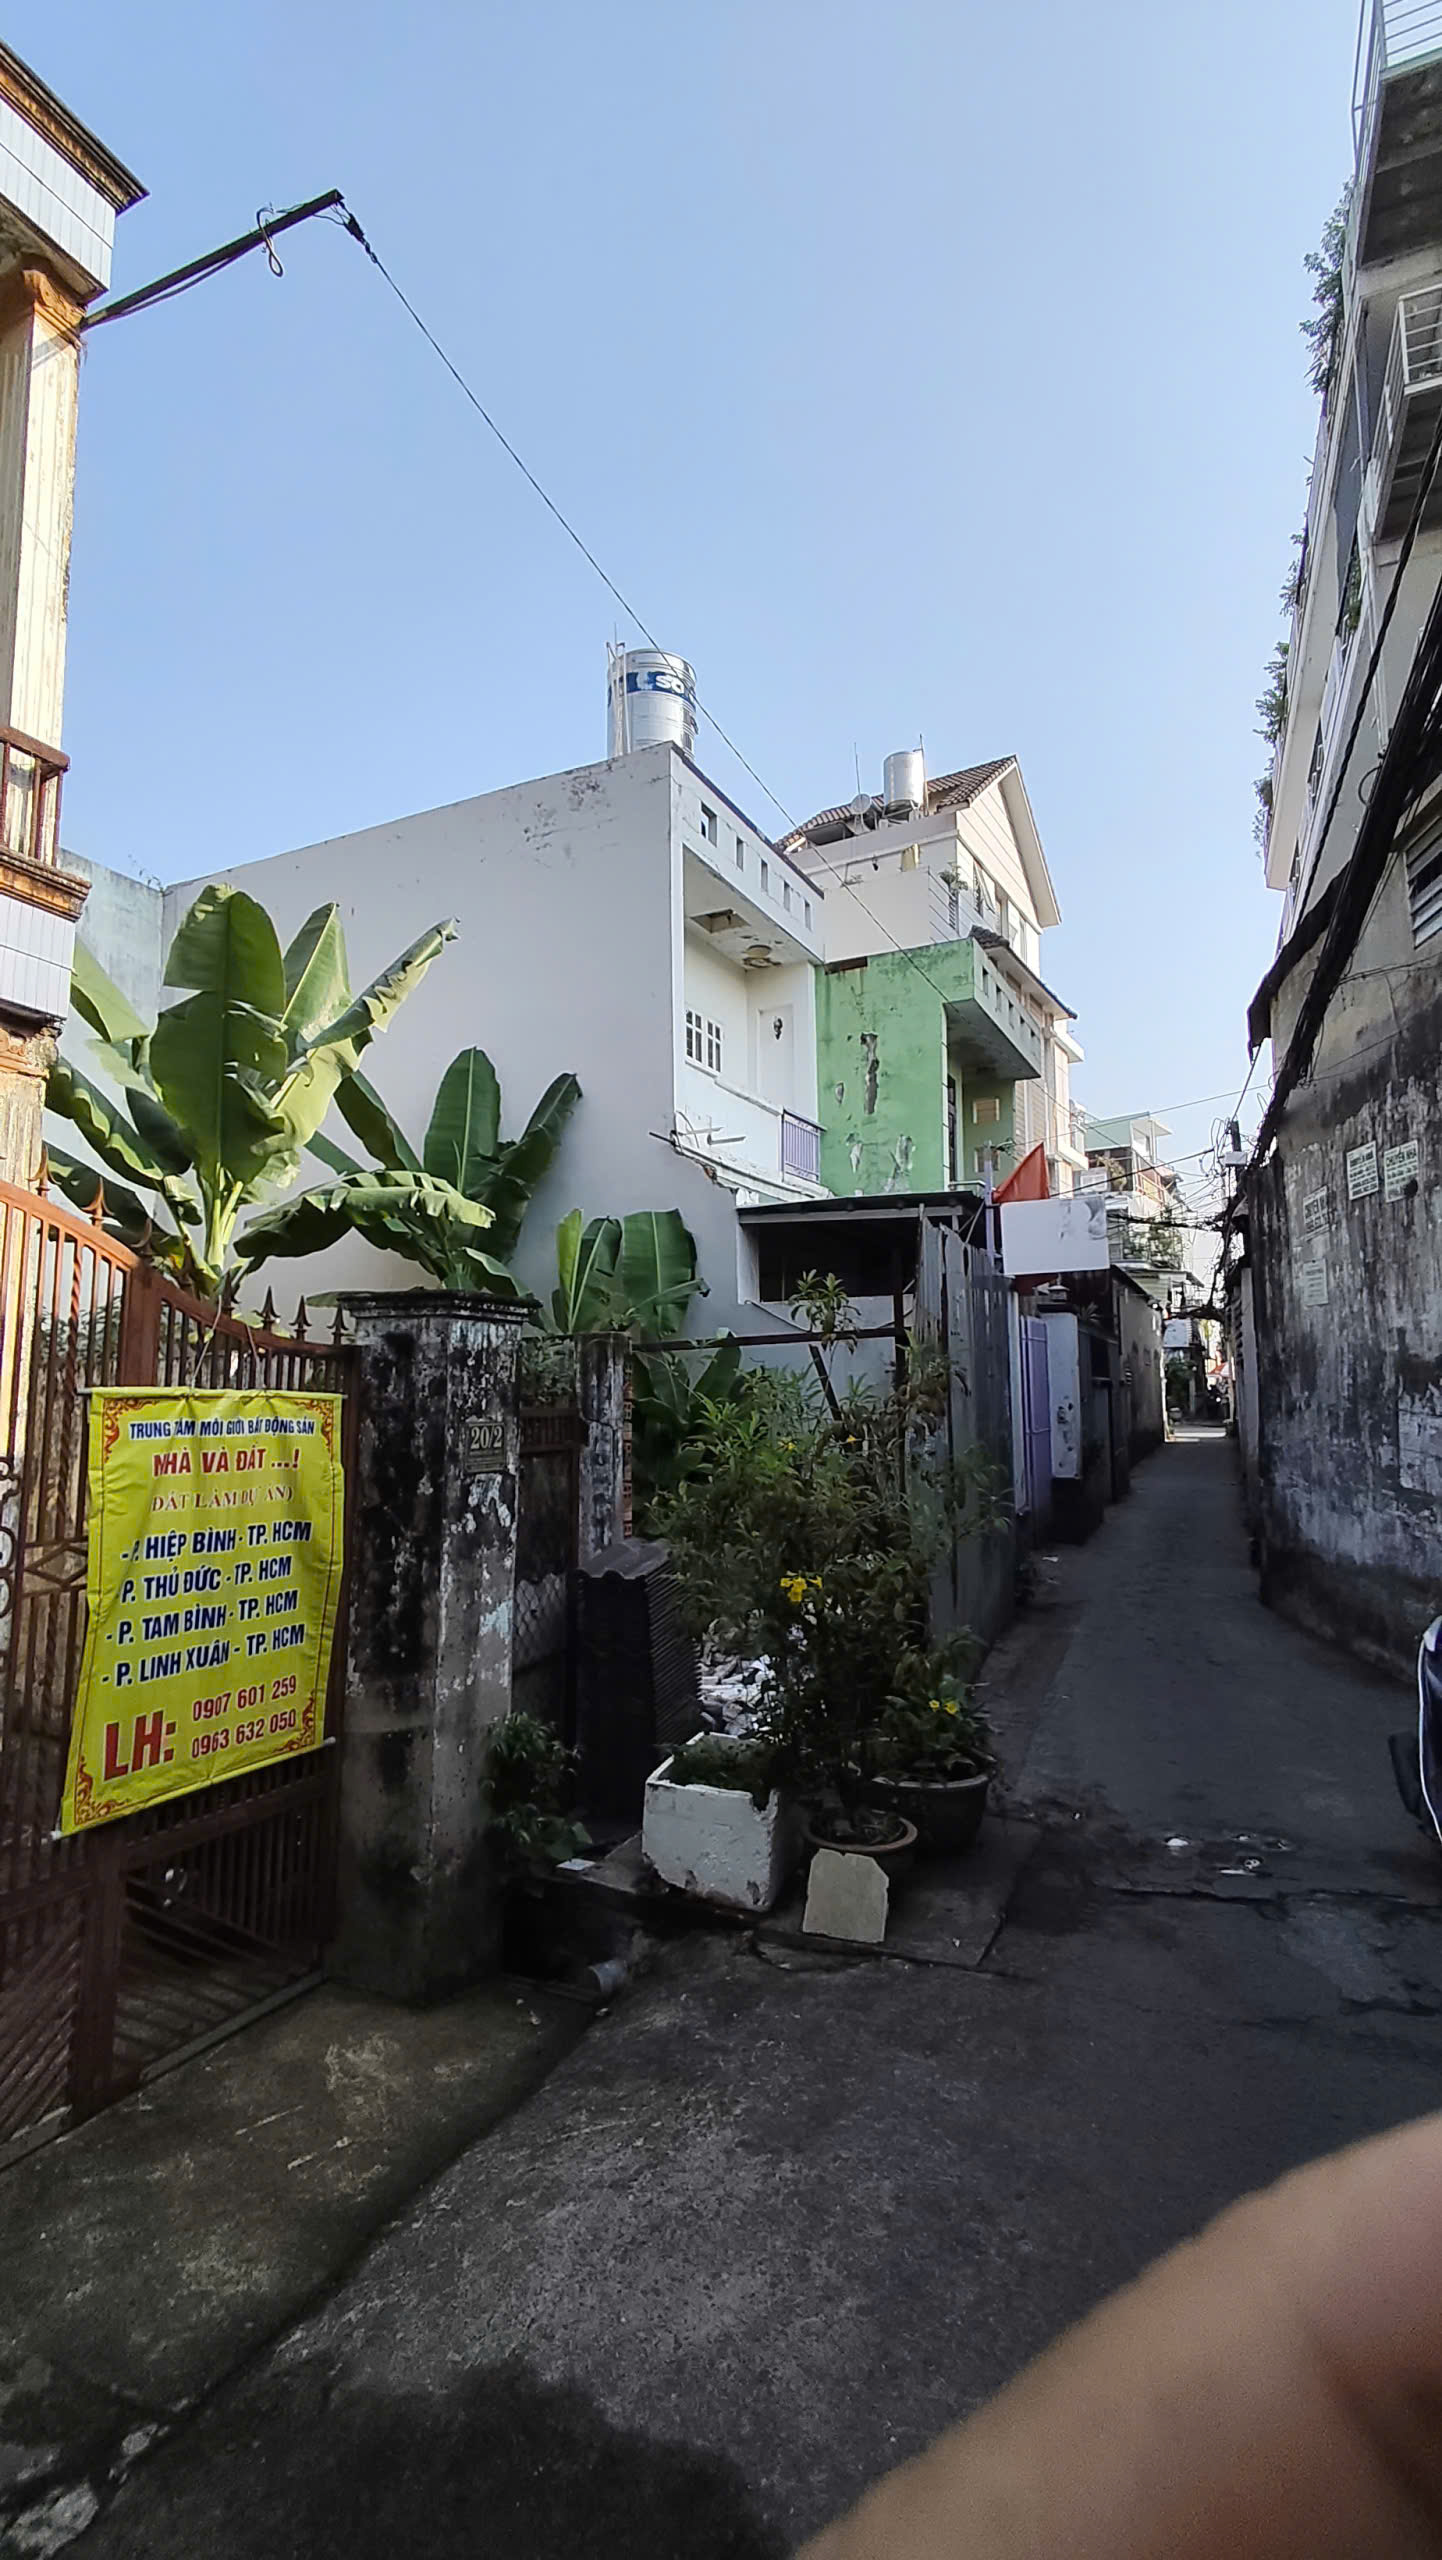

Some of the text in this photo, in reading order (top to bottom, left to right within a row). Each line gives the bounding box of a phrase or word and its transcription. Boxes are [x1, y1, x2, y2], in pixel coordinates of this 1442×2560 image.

[130, 1421, 171, 1440] TRUNG
[174, 1416, 196, 1436] TÂM
[200, 1417, 224, 1436] MÔI
[264, 1415, 294, 1436] ĐỘNG
[296, 1415, 315, 1435] SẢN
[470, 1424, 503, 1450] 20/2
[153, 1446, 192, 1477] NHÀ
[201, 1446, 229, 1473] VÀ
[235, 1441, 266, 1472] ĐẤT
[194, 1487, 237, 1508] LÀM
[145, 1529, 187, 1562] HIỆP
[192, 1526, 237, 1553] BÌNH
[247, 1524, 268, 1546] TP.
[272, 1520, 312, 1543] HCM
[143, 1565, 179, 1600] THỦ
[183, 1564, 222, 1594] ĐỨC
[234, 1562, 253, 1585] TP.
[258, 1555, 292, 1581] HCM
[142, 1612, 180, 1641] TAM
[184, 1603, 227, 1632] BÌNH
[238, 1597, 261, 1621] TP.
[265, 1589, 299, 1617] HCM
[139, 1650, 182, 1682] LINH
[185, 1639, 230, 1672] XUÂN
[246, 1632, 268, 1657] TP.
[271, 1623, 305, 1651] HCM
[192, 1674, 297, 1722] 0907 601 259
[104, 1710, 176, 1781] LH:
[191, 1708, 297, 1759] 0963 632 050
